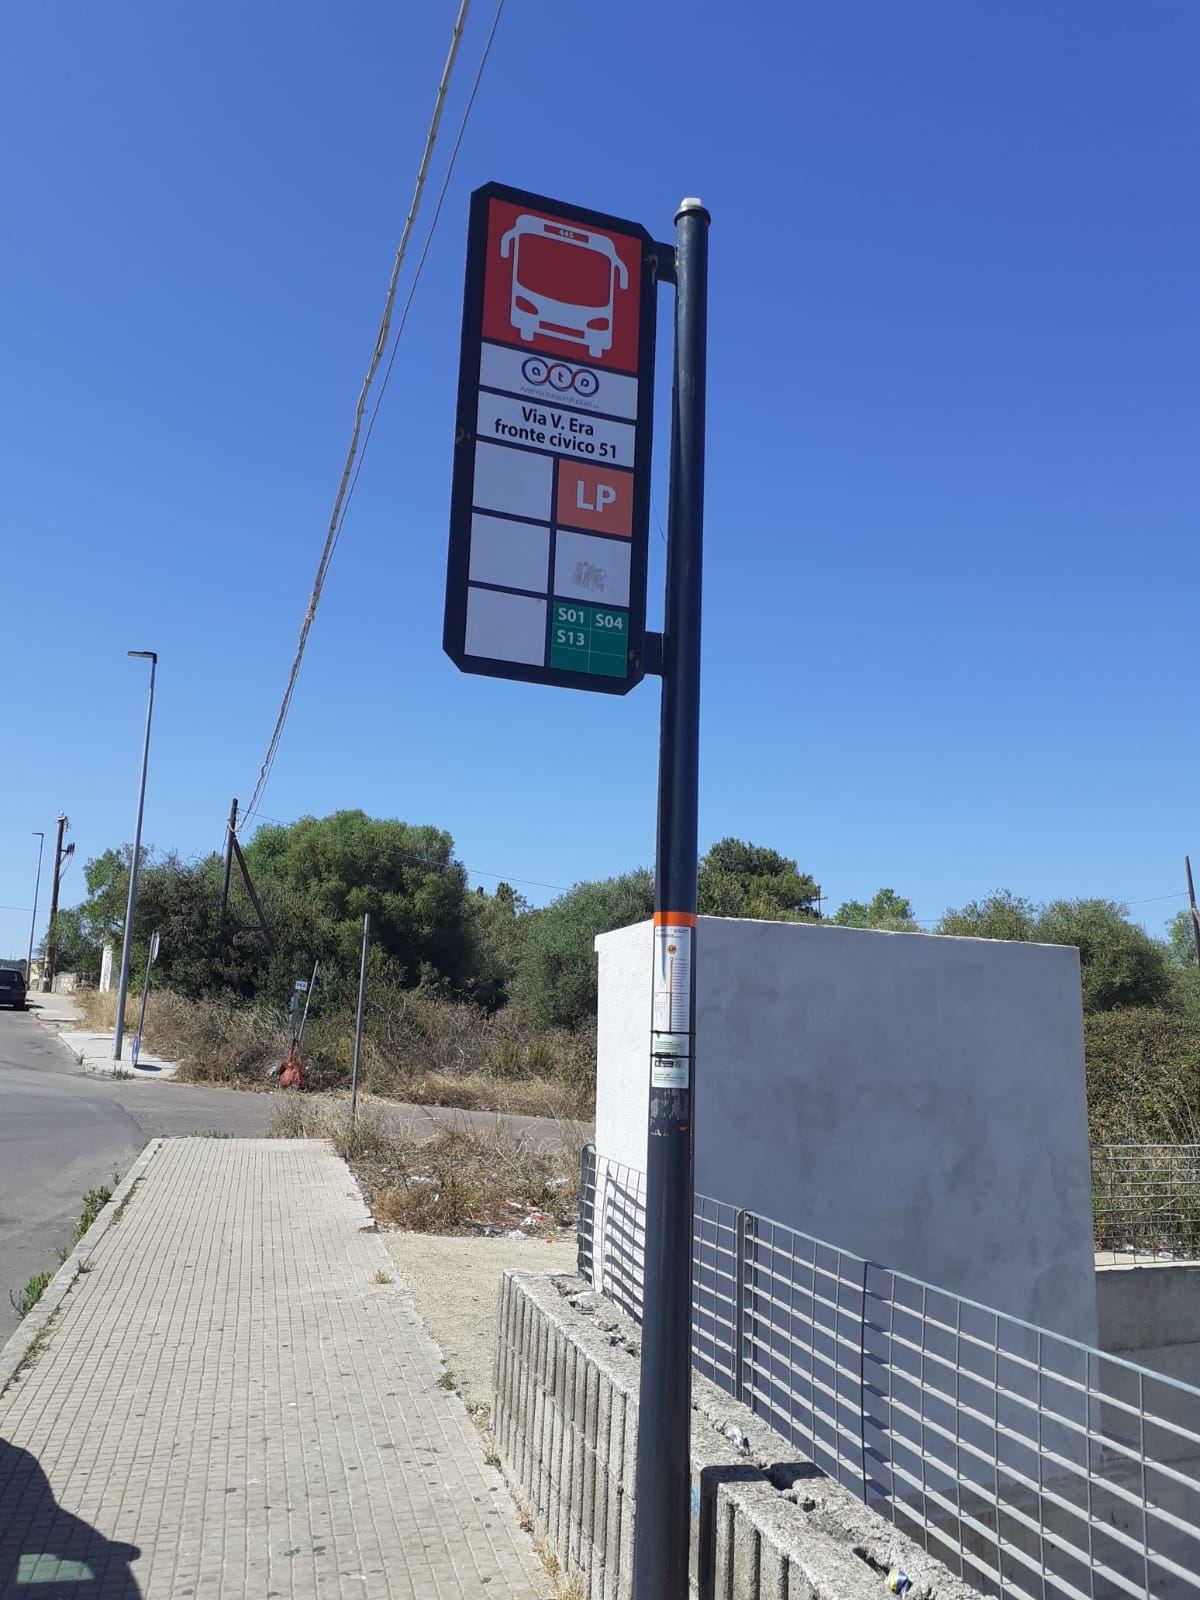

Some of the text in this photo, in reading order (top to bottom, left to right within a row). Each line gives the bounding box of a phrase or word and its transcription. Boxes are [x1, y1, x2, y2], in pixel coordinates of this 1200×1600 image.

[522, 406, 594, 436] Via V. Era
[495, 418, 616, 459] fronte civico 51
[576, 480, 617, 512] LP
[558, 607, 623, 630] S01 S04
[557, 629, 585, 646] S13
